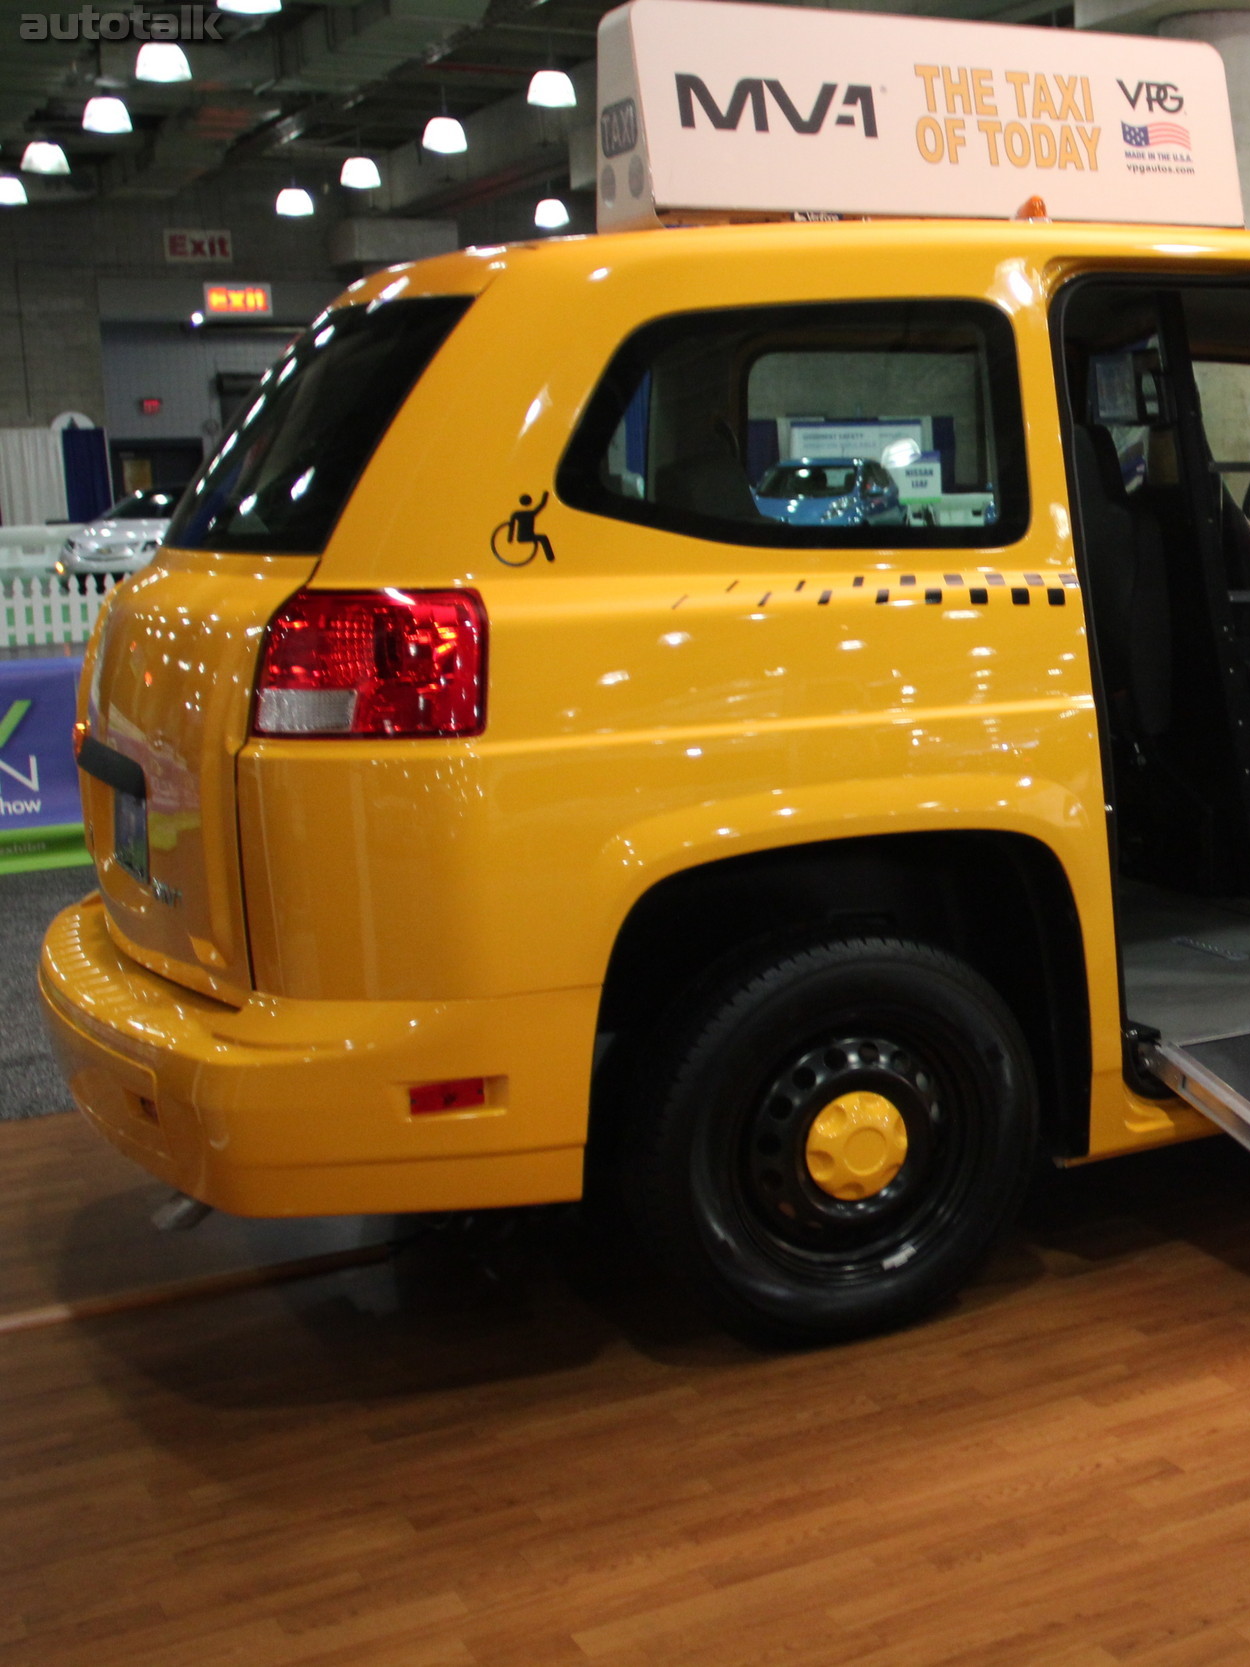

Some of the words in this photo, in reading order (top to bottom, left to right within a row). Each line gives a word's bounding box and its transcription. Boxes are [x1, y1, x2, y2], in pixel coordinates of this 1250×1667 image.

[914, 64, 998, 116] THE
[1005, 71, 1094, 122] TAXI
[1116, 79, 1184, 114] VPG
[601, 105, 636, 150] TAXI
[915, 115, 966, 164] OF
[977, 119, 1101, 171] TODAY
[1124, 151, 1146, 160] MADE
[1148, 152, 1156, 160] IN
[1157, 153, 1171, 161] THE
[1126, 163, 1195, 175] vpgautos.com
[169, 234, 230, 257] Exit
[208, 287, 269, 312] Exit
